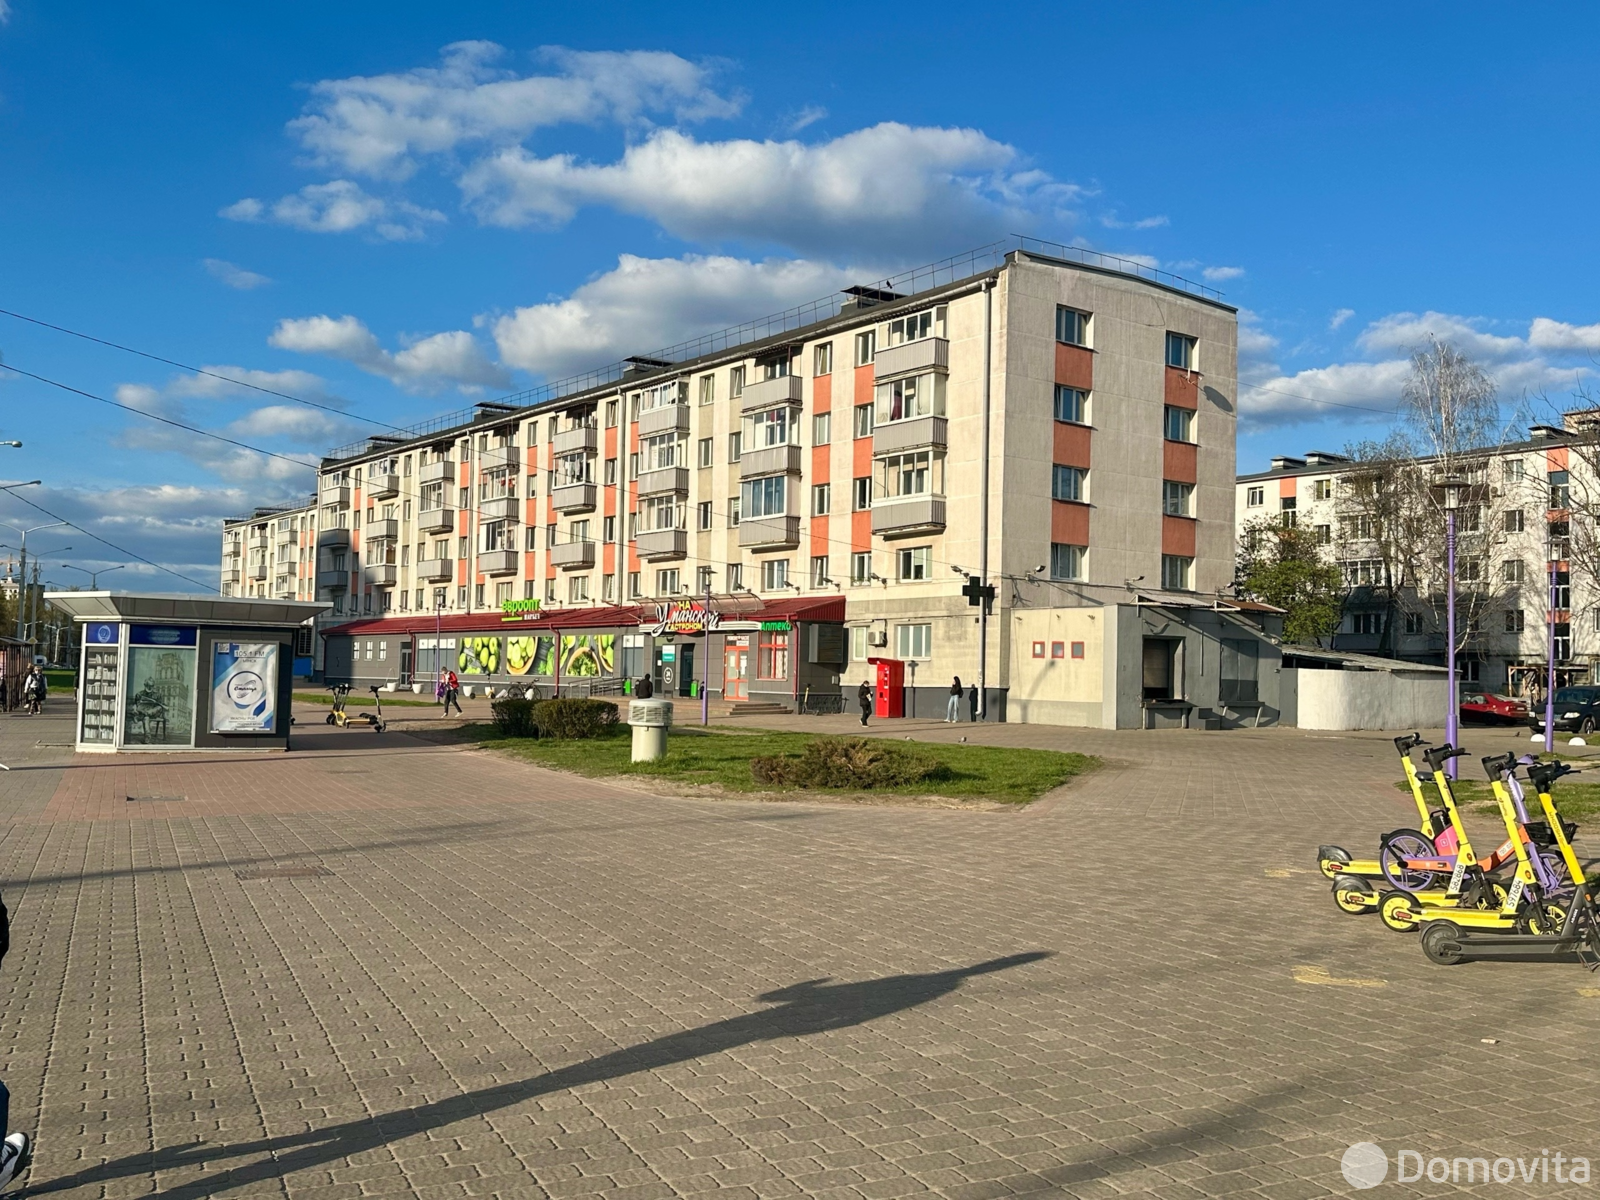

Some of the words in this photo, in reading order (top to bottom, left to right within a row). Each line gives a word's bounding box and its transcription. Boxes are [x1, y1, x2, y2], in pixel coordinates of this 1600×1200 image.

[678, 601, 691, 610] НА
[1451, 864, 1464, 891] 582868
[1507, 880, 1522, 907] 597684
